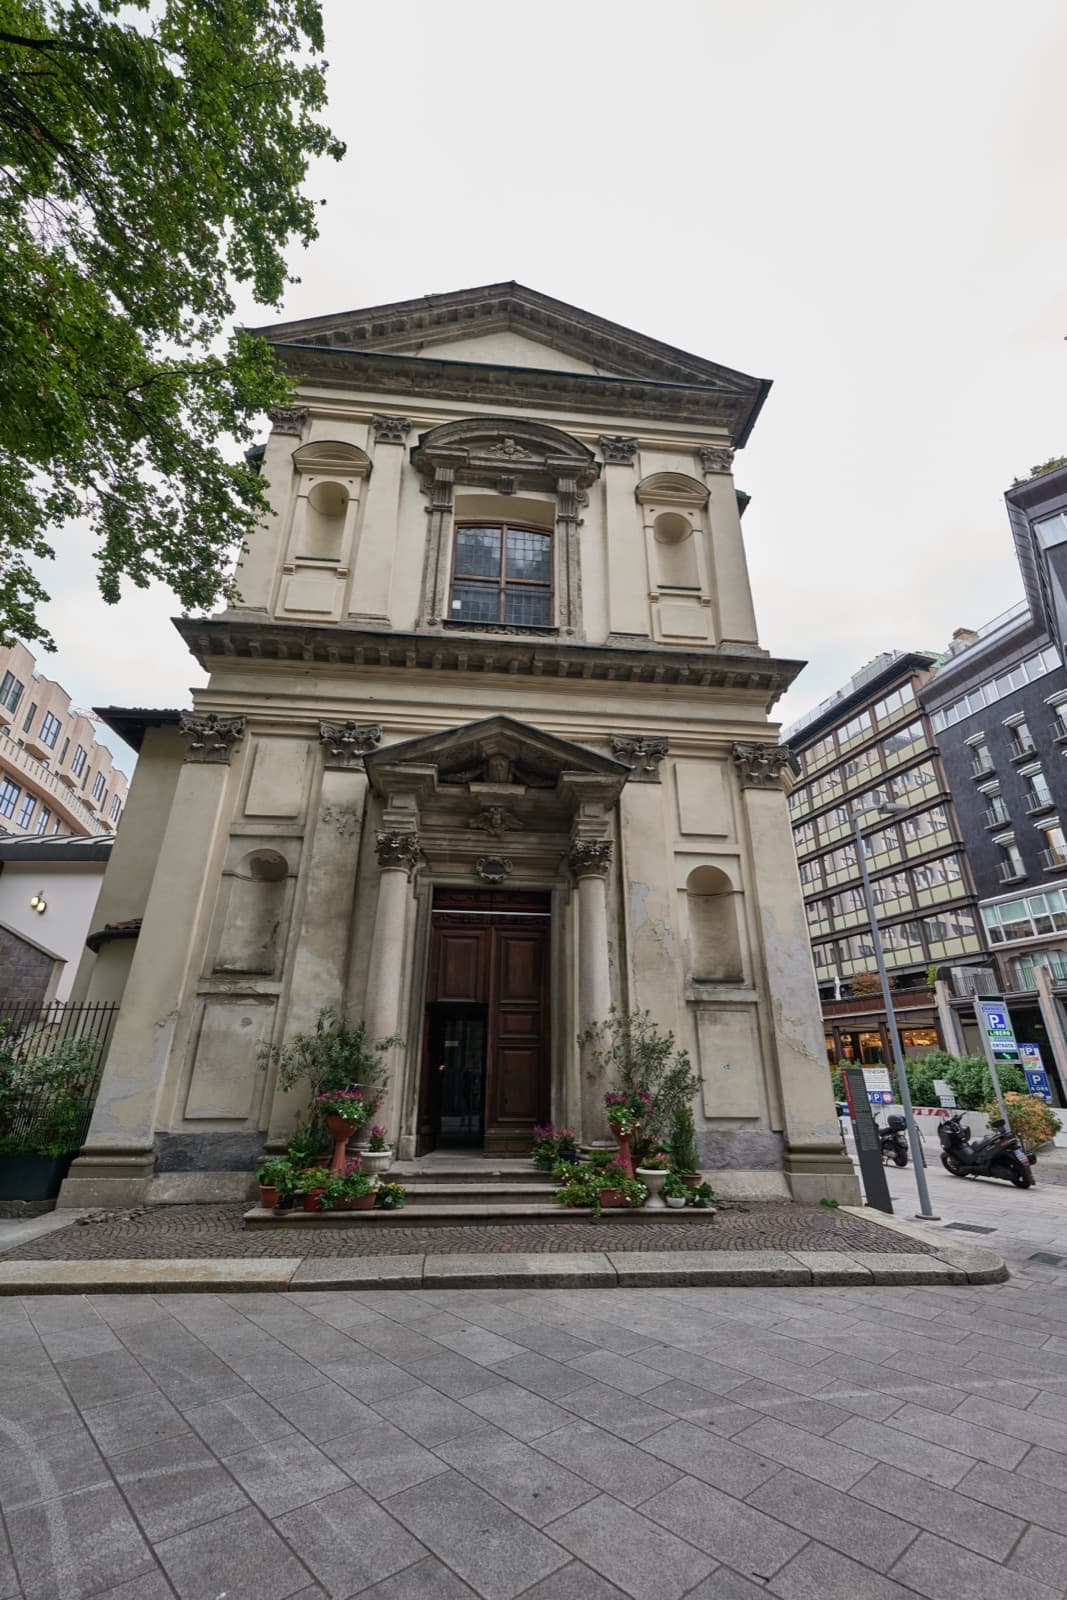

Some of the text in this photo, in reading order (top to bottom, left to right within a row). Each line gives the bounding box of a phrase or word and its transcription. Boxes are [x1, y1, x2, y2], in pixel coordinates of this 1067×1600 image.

[989, 1014, 999, 1029] P
[1025, 1047, 1033, 1055] P
[1032, 1075, 1041, 1085] P
